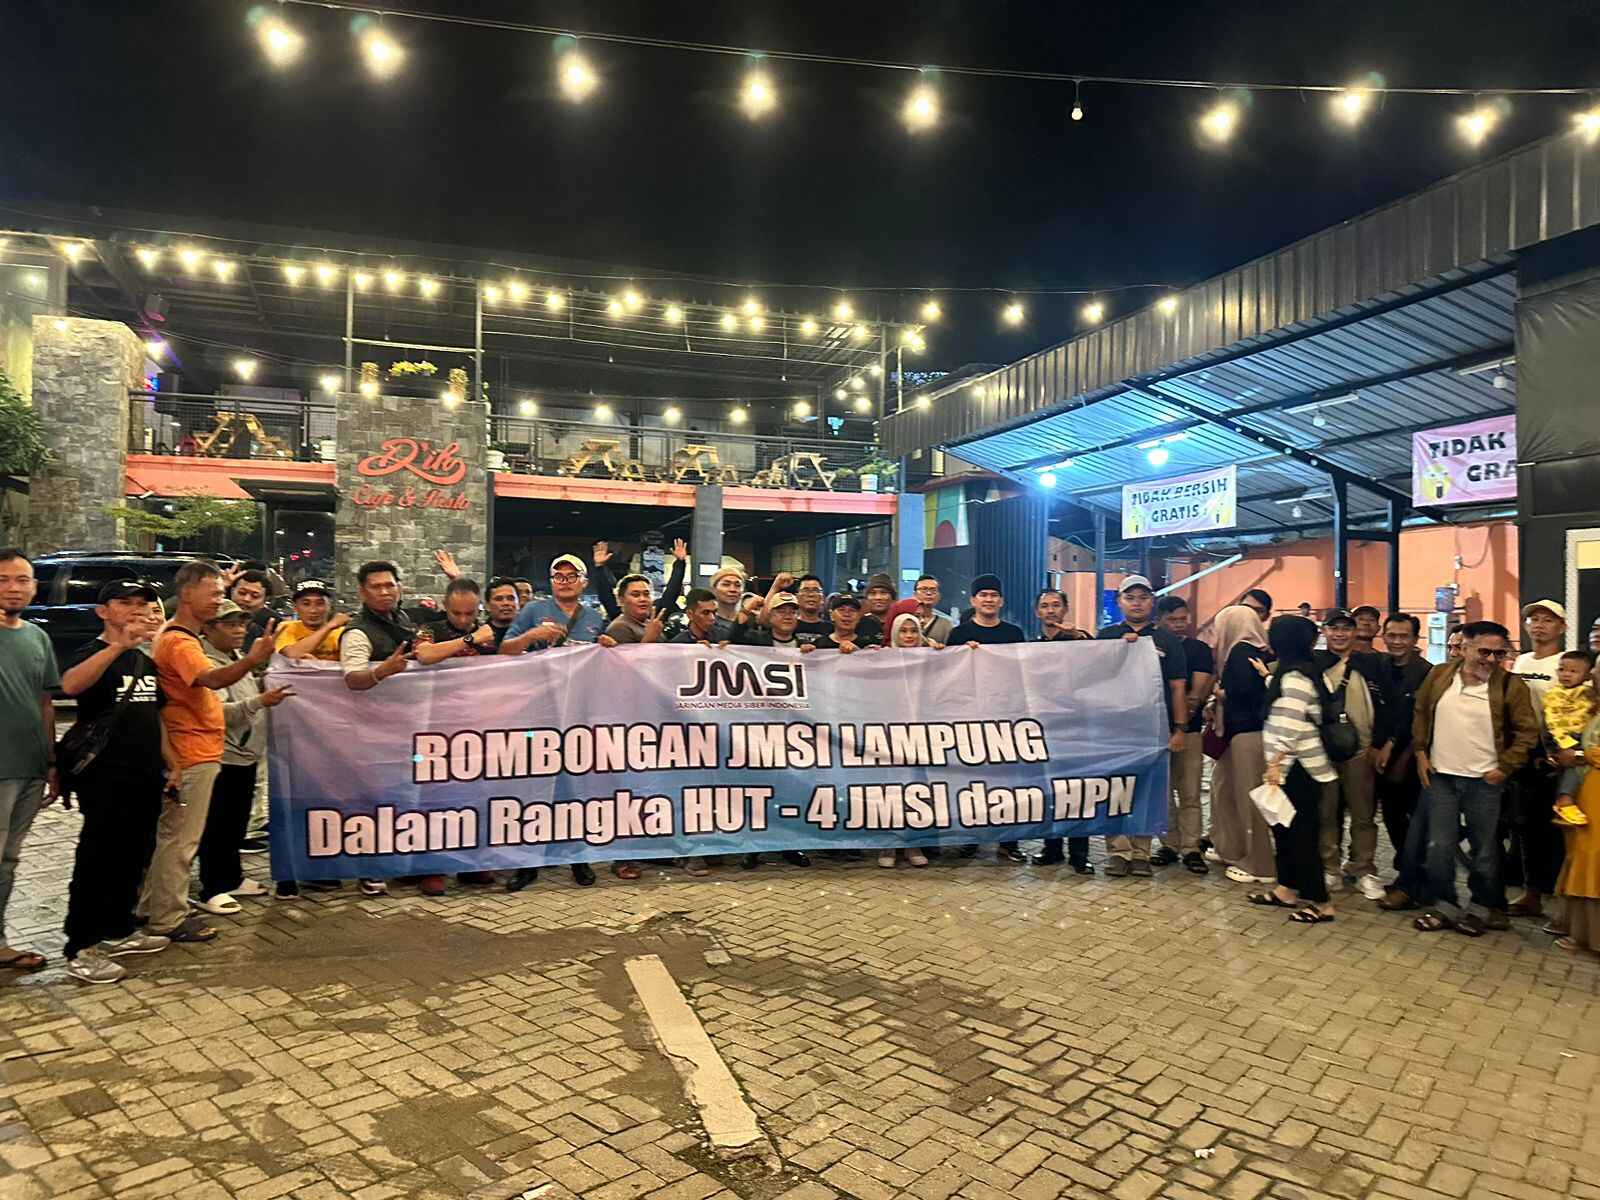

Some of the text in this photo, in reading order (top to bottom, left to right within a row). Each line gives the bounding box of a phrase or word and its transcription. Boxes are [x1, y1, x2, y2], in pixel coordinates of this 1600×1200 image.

[1428, 431, 1506, 459] TIDAK
[1131, 478, 1228, 505] TIDAK BERSIH
[679, 660, 805, 698] JMSI
[413, 719, 1049, 783] ROMBONGAN JMSI LAMPUNG
[308, 806, 478, 857] Dalam
[488, 790, 674, 846] Rangka
[682, 785, 773, 833] HUT
[806, 786, 837, 829] 4
[844, 782, 949, 830] JMSI
[958, 781, 1044, 827] dan
[1052, 775, 1137, 821] HPN
